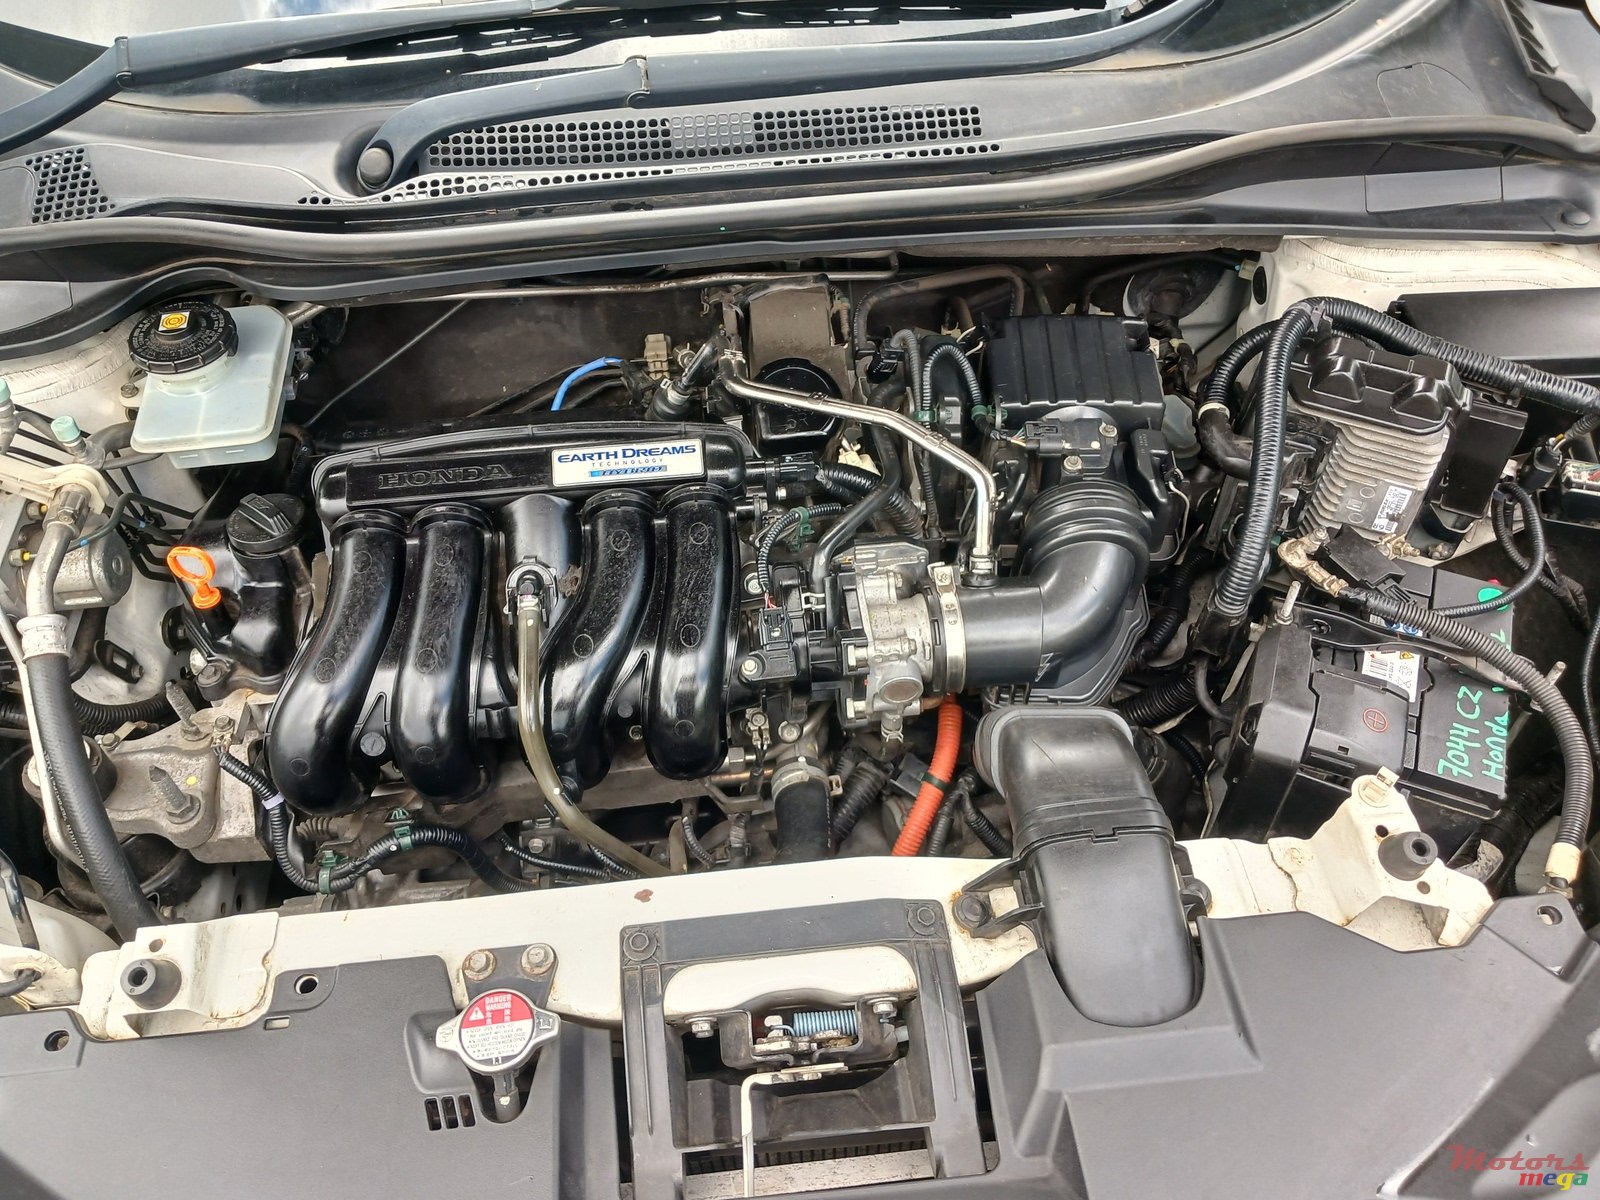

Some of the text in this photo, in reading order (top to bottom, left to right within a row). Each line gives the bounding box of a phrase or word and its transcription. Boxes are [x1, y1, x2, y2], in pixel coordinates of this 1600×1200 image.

[557, 444, 697, 463] EARTH DREAMS
[592, 458, 664, 468] TECHNOLOGY
[378, 464, 513, 490] HONDA
[1437, 722, 1482, 778] 7044
[1481, 711, 1509, 781] Honda
[485, 994, 512, 1005] DANGER
